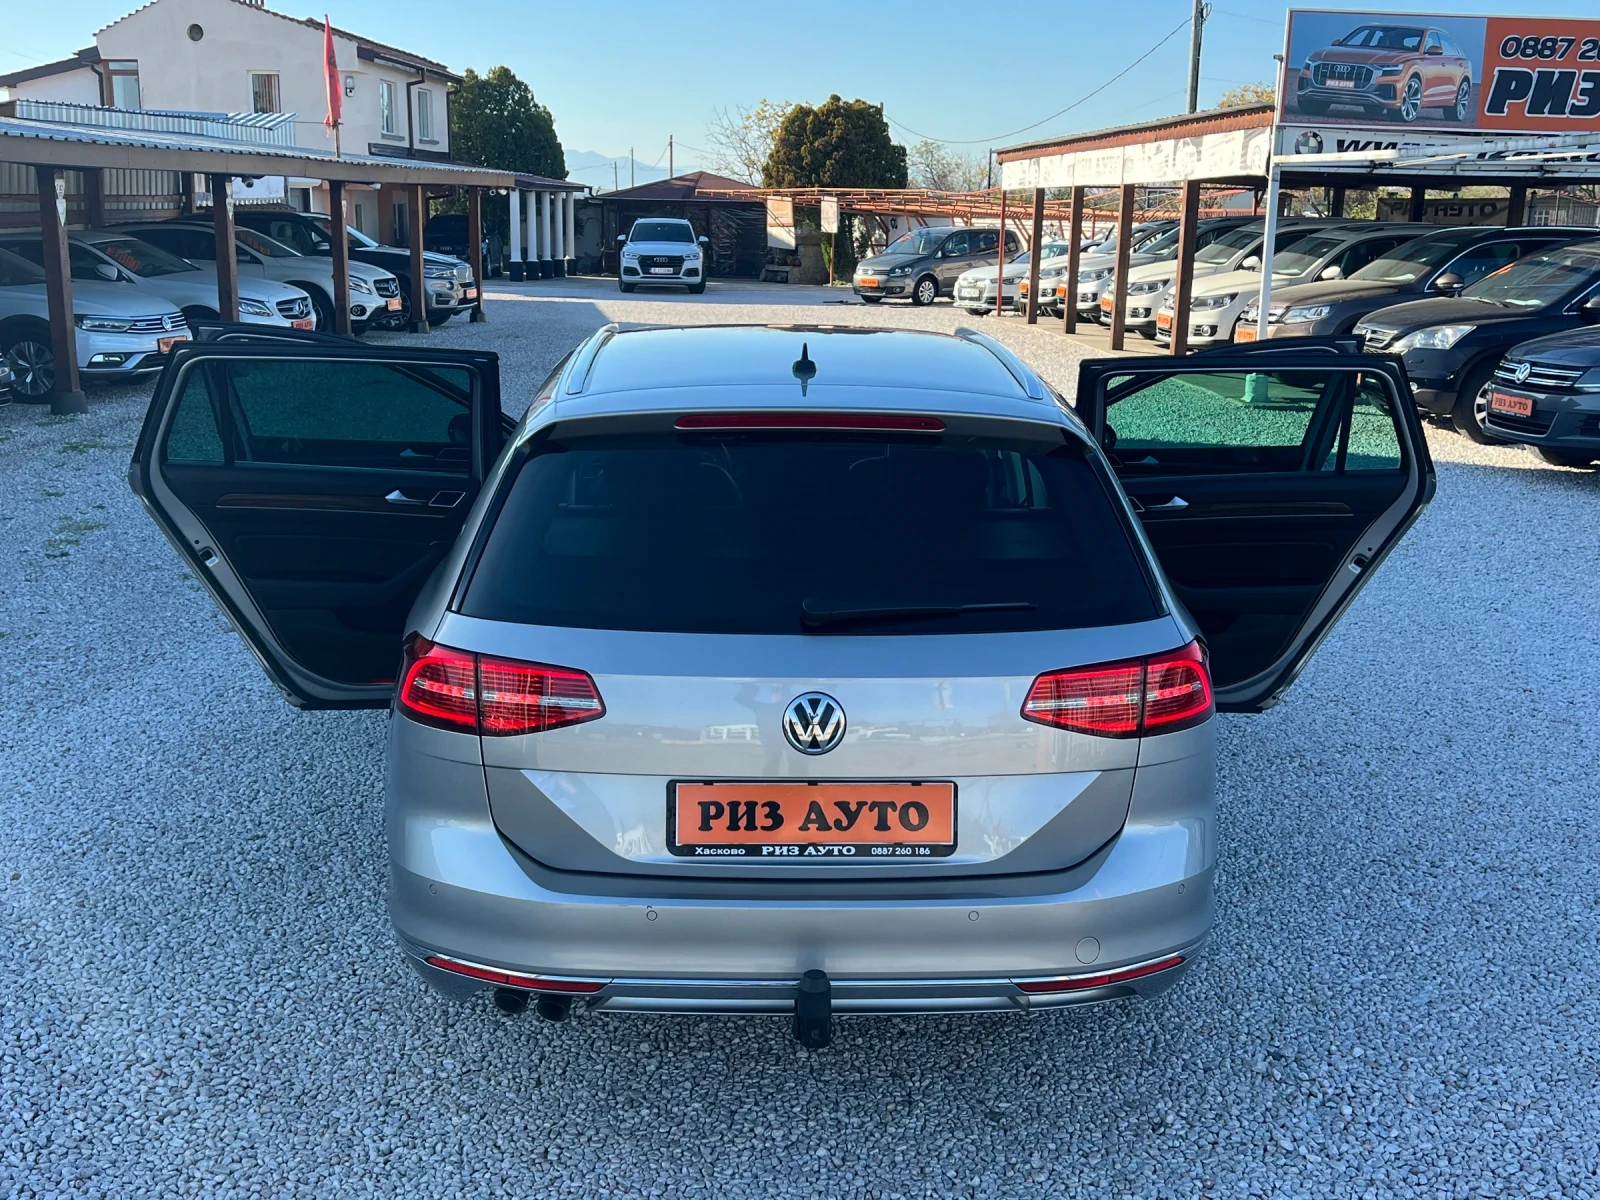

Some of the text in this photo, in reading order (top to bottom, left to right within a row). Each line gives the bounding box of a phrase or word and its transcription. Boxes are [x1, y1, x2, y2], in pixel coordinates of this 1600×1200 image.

[1500, 34, 1600, 62] 0887 2
[1485, 66, 1600, 119] РИЗ
[1507, 399, 1528, 411] АУТО
[698, 800, 930, 832] РИЗ АУТО
[695, 846, 746, 856] Хасково
[762, 845, 856, 856] РИЗ АУТО
[871, 847, 931, 856] 0887 260 186
